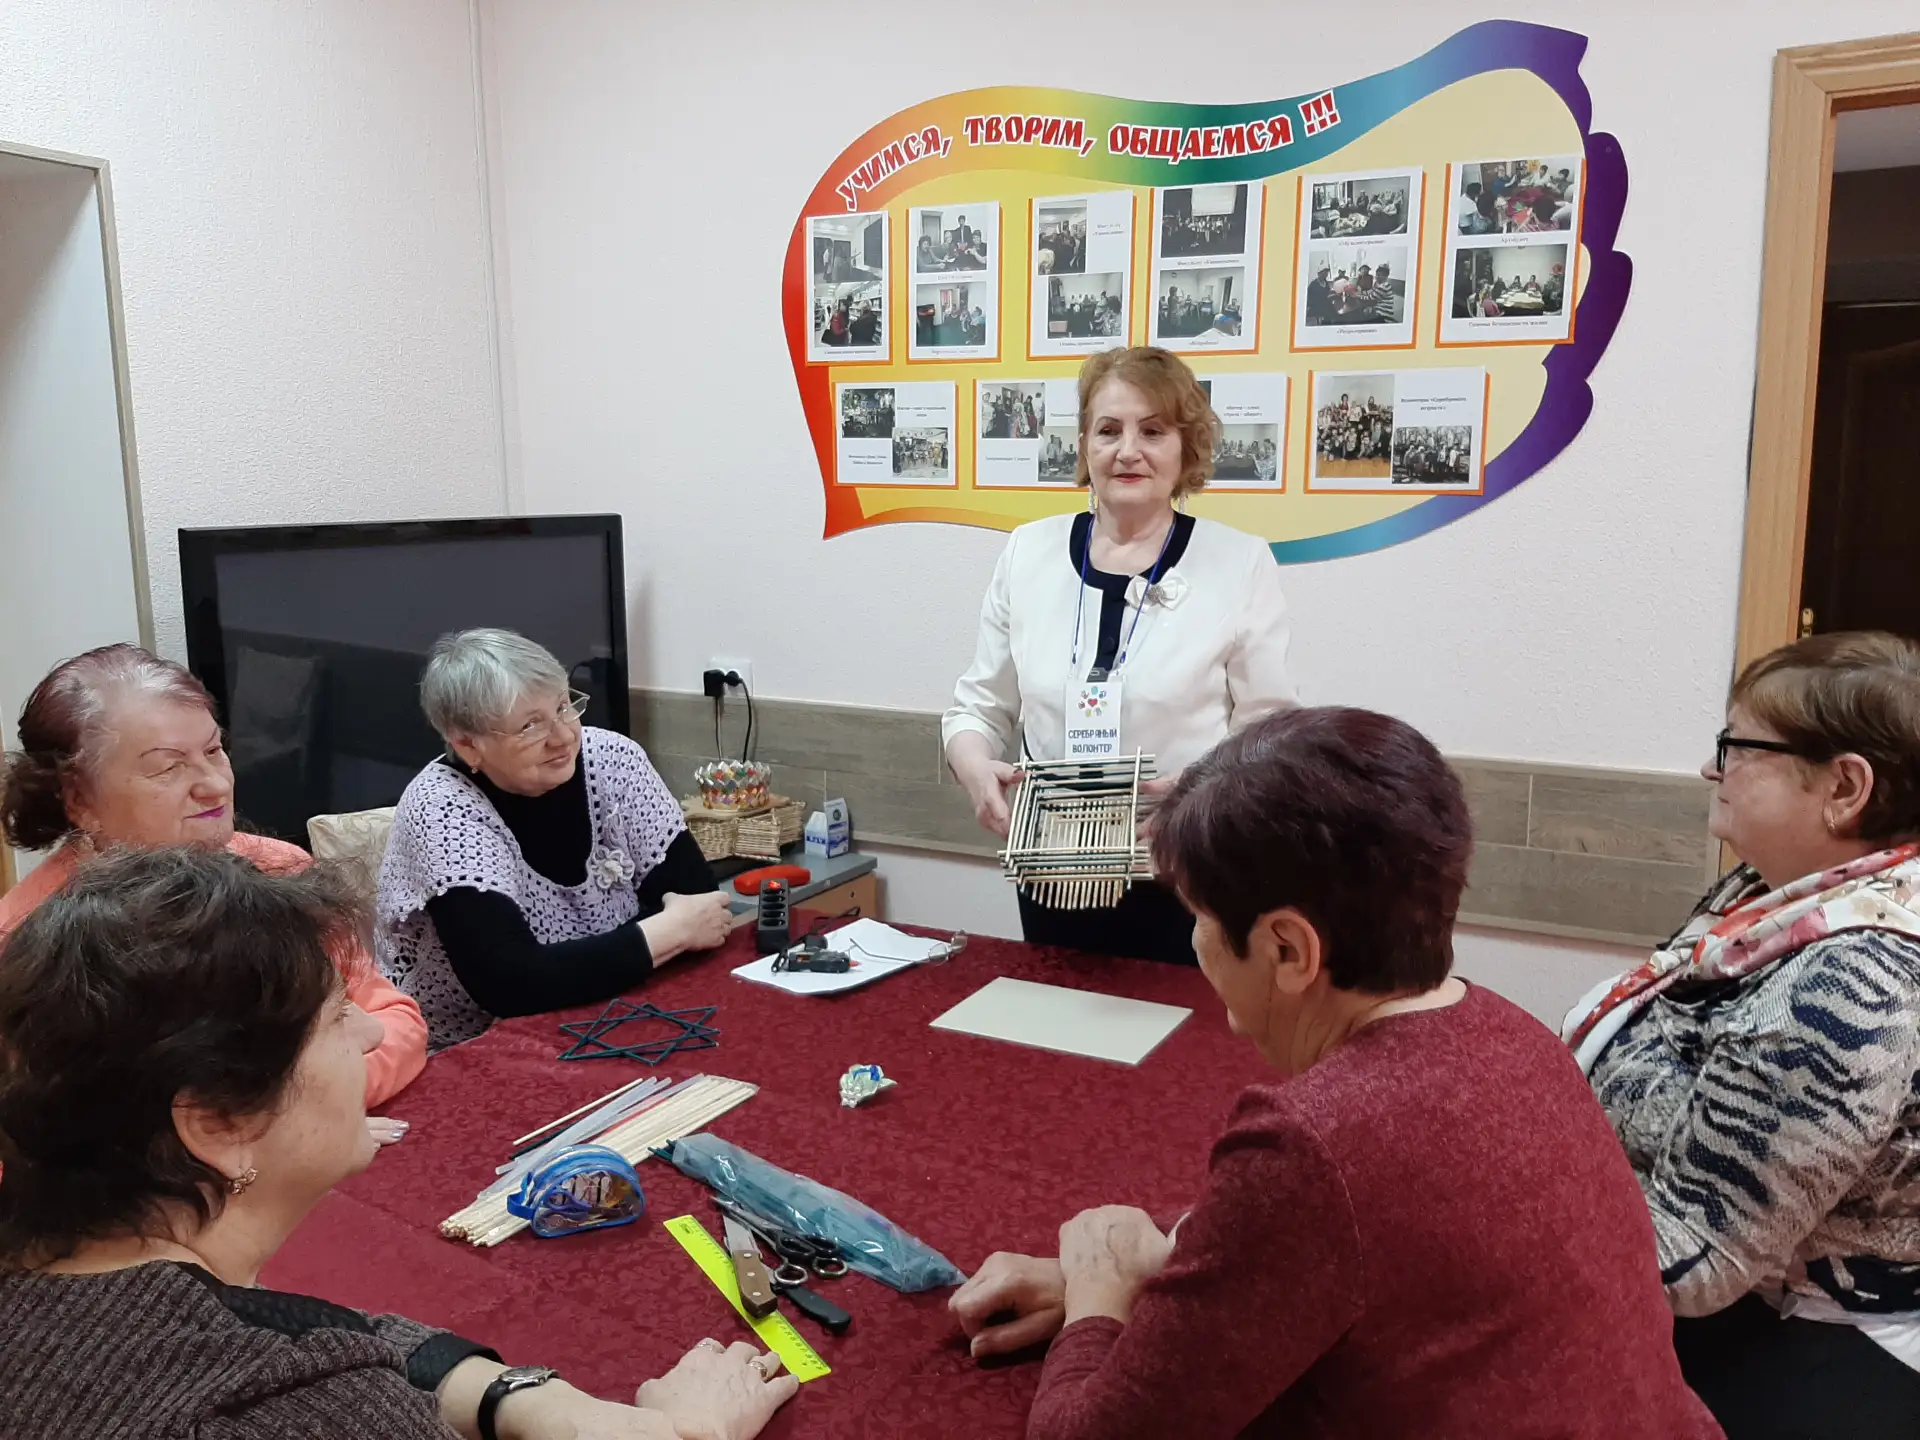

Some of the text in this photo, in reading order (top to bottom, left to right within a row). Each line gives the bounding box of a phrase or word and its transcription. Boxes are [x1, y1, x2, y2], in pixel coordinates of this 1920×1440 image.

[836, 90, 1341, 212] УЧИМСЯ, ТВОРИМ, ОБЩАЕМСЯ !!!
[1068, 728, 1117, 738] СЕРЕБРЯНЫЙ
[1073, 743, 1112, 753] ВОЛОНТЕР
